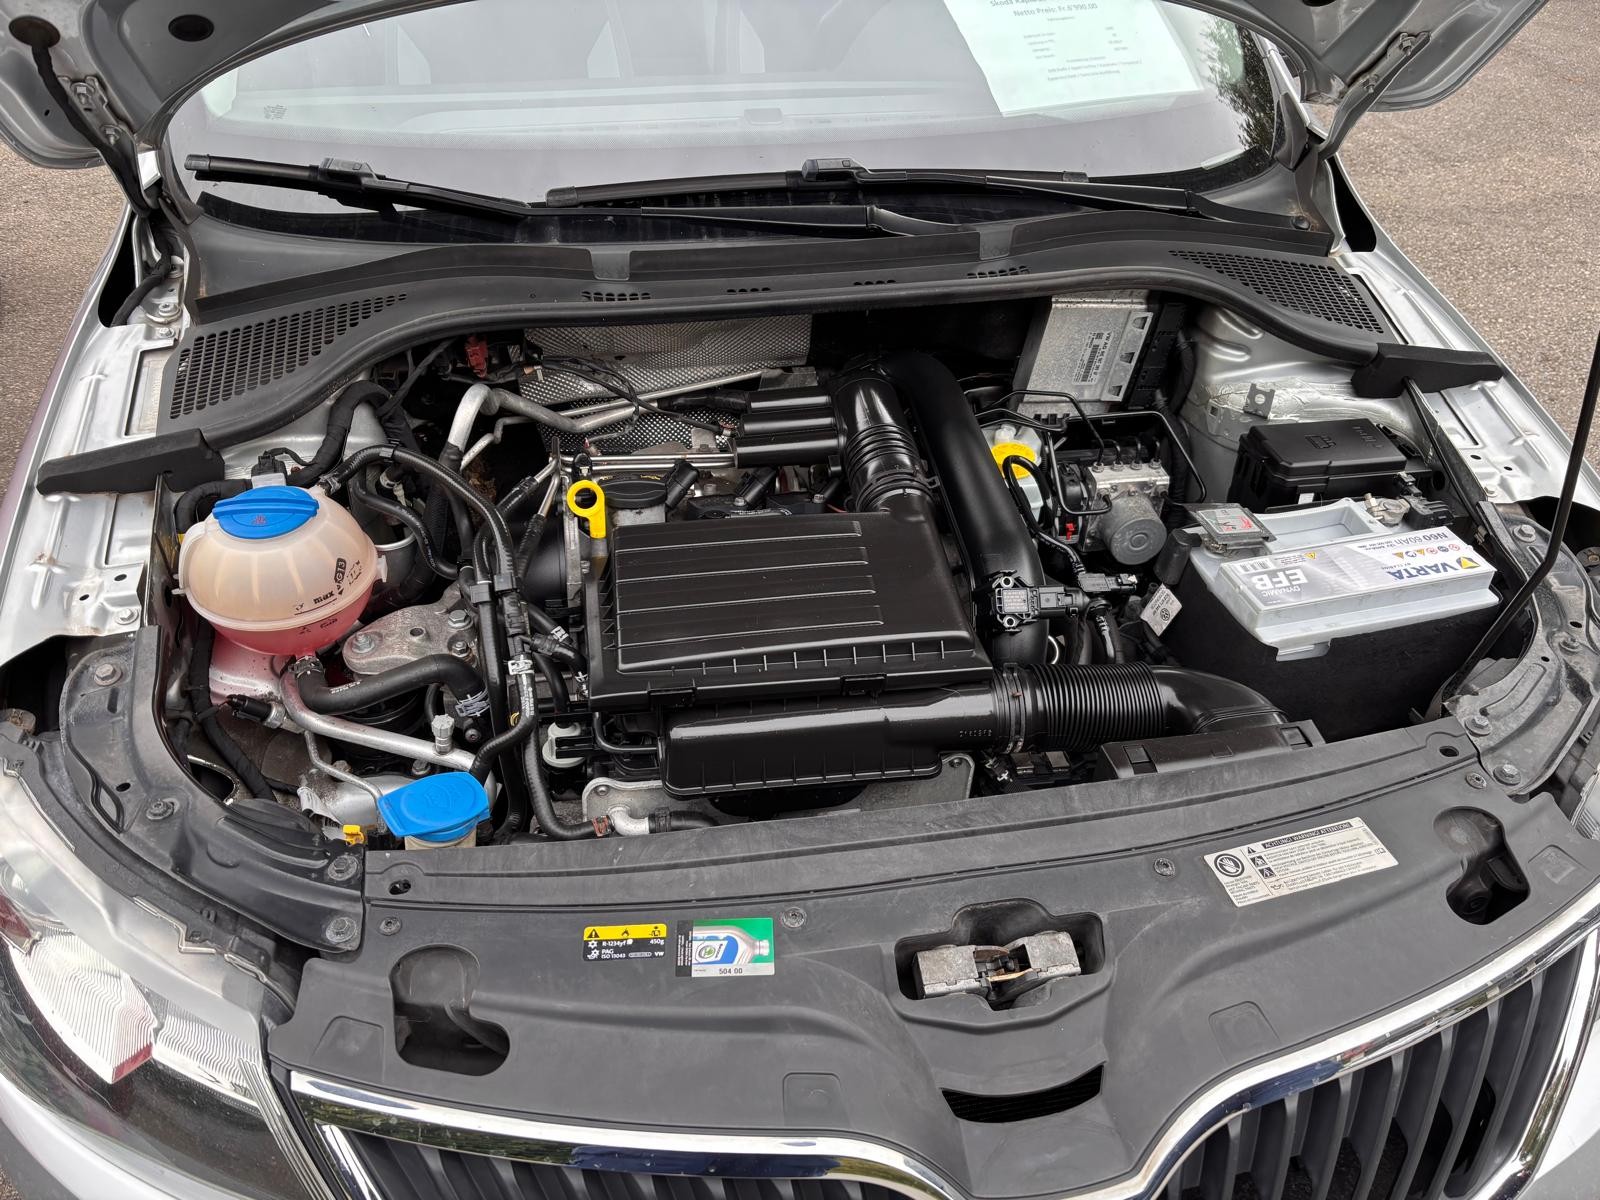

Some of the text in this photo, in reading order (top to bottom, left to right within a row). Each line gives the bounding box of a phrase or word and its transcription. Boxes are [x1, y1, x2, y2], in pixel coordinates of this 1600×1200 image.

[1422, 531, 1448, 541] N60
[335, 560, 346, 580] G13
[1386, 562, 1460, 580] VARTA
[1251, 568, 1308, 591] EFB
[1261, 586, 1301, 597] DYNAMIC
[313, 591, 335, 605] max
[602, 938, 665, 948] R-1234yf 450g
[719, 967, 743, 975] 504 00
